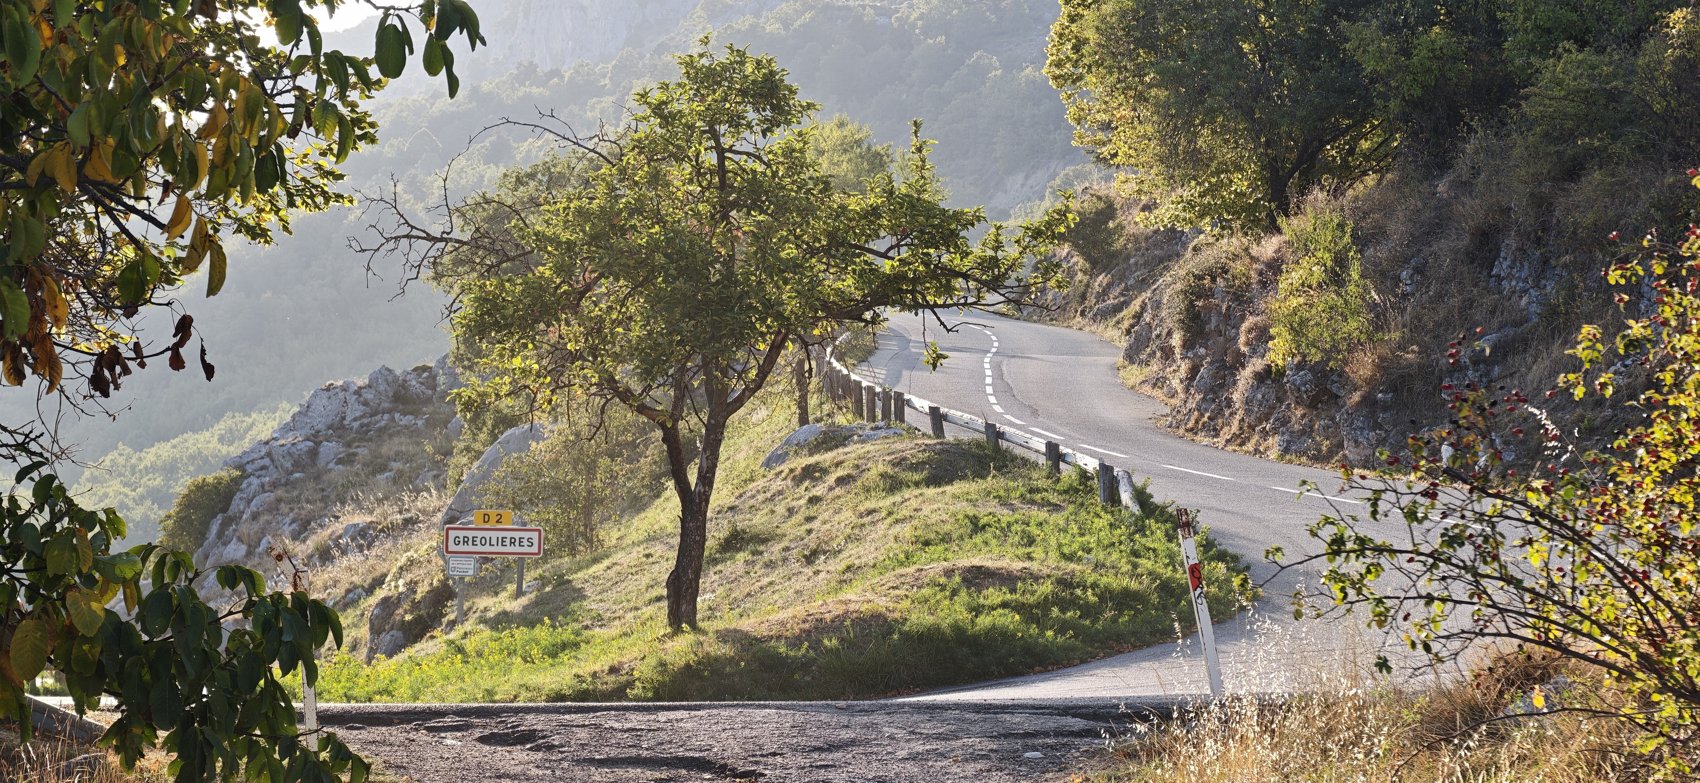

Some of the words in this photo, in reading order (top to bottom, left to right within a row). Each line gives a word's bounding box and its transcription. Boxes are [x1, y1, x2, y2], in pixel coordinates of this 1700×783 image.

[483, 513, 490, 523] D
[495, 513, 503, 523] 2
[453, 535, 534, 548] GREOLIERES
